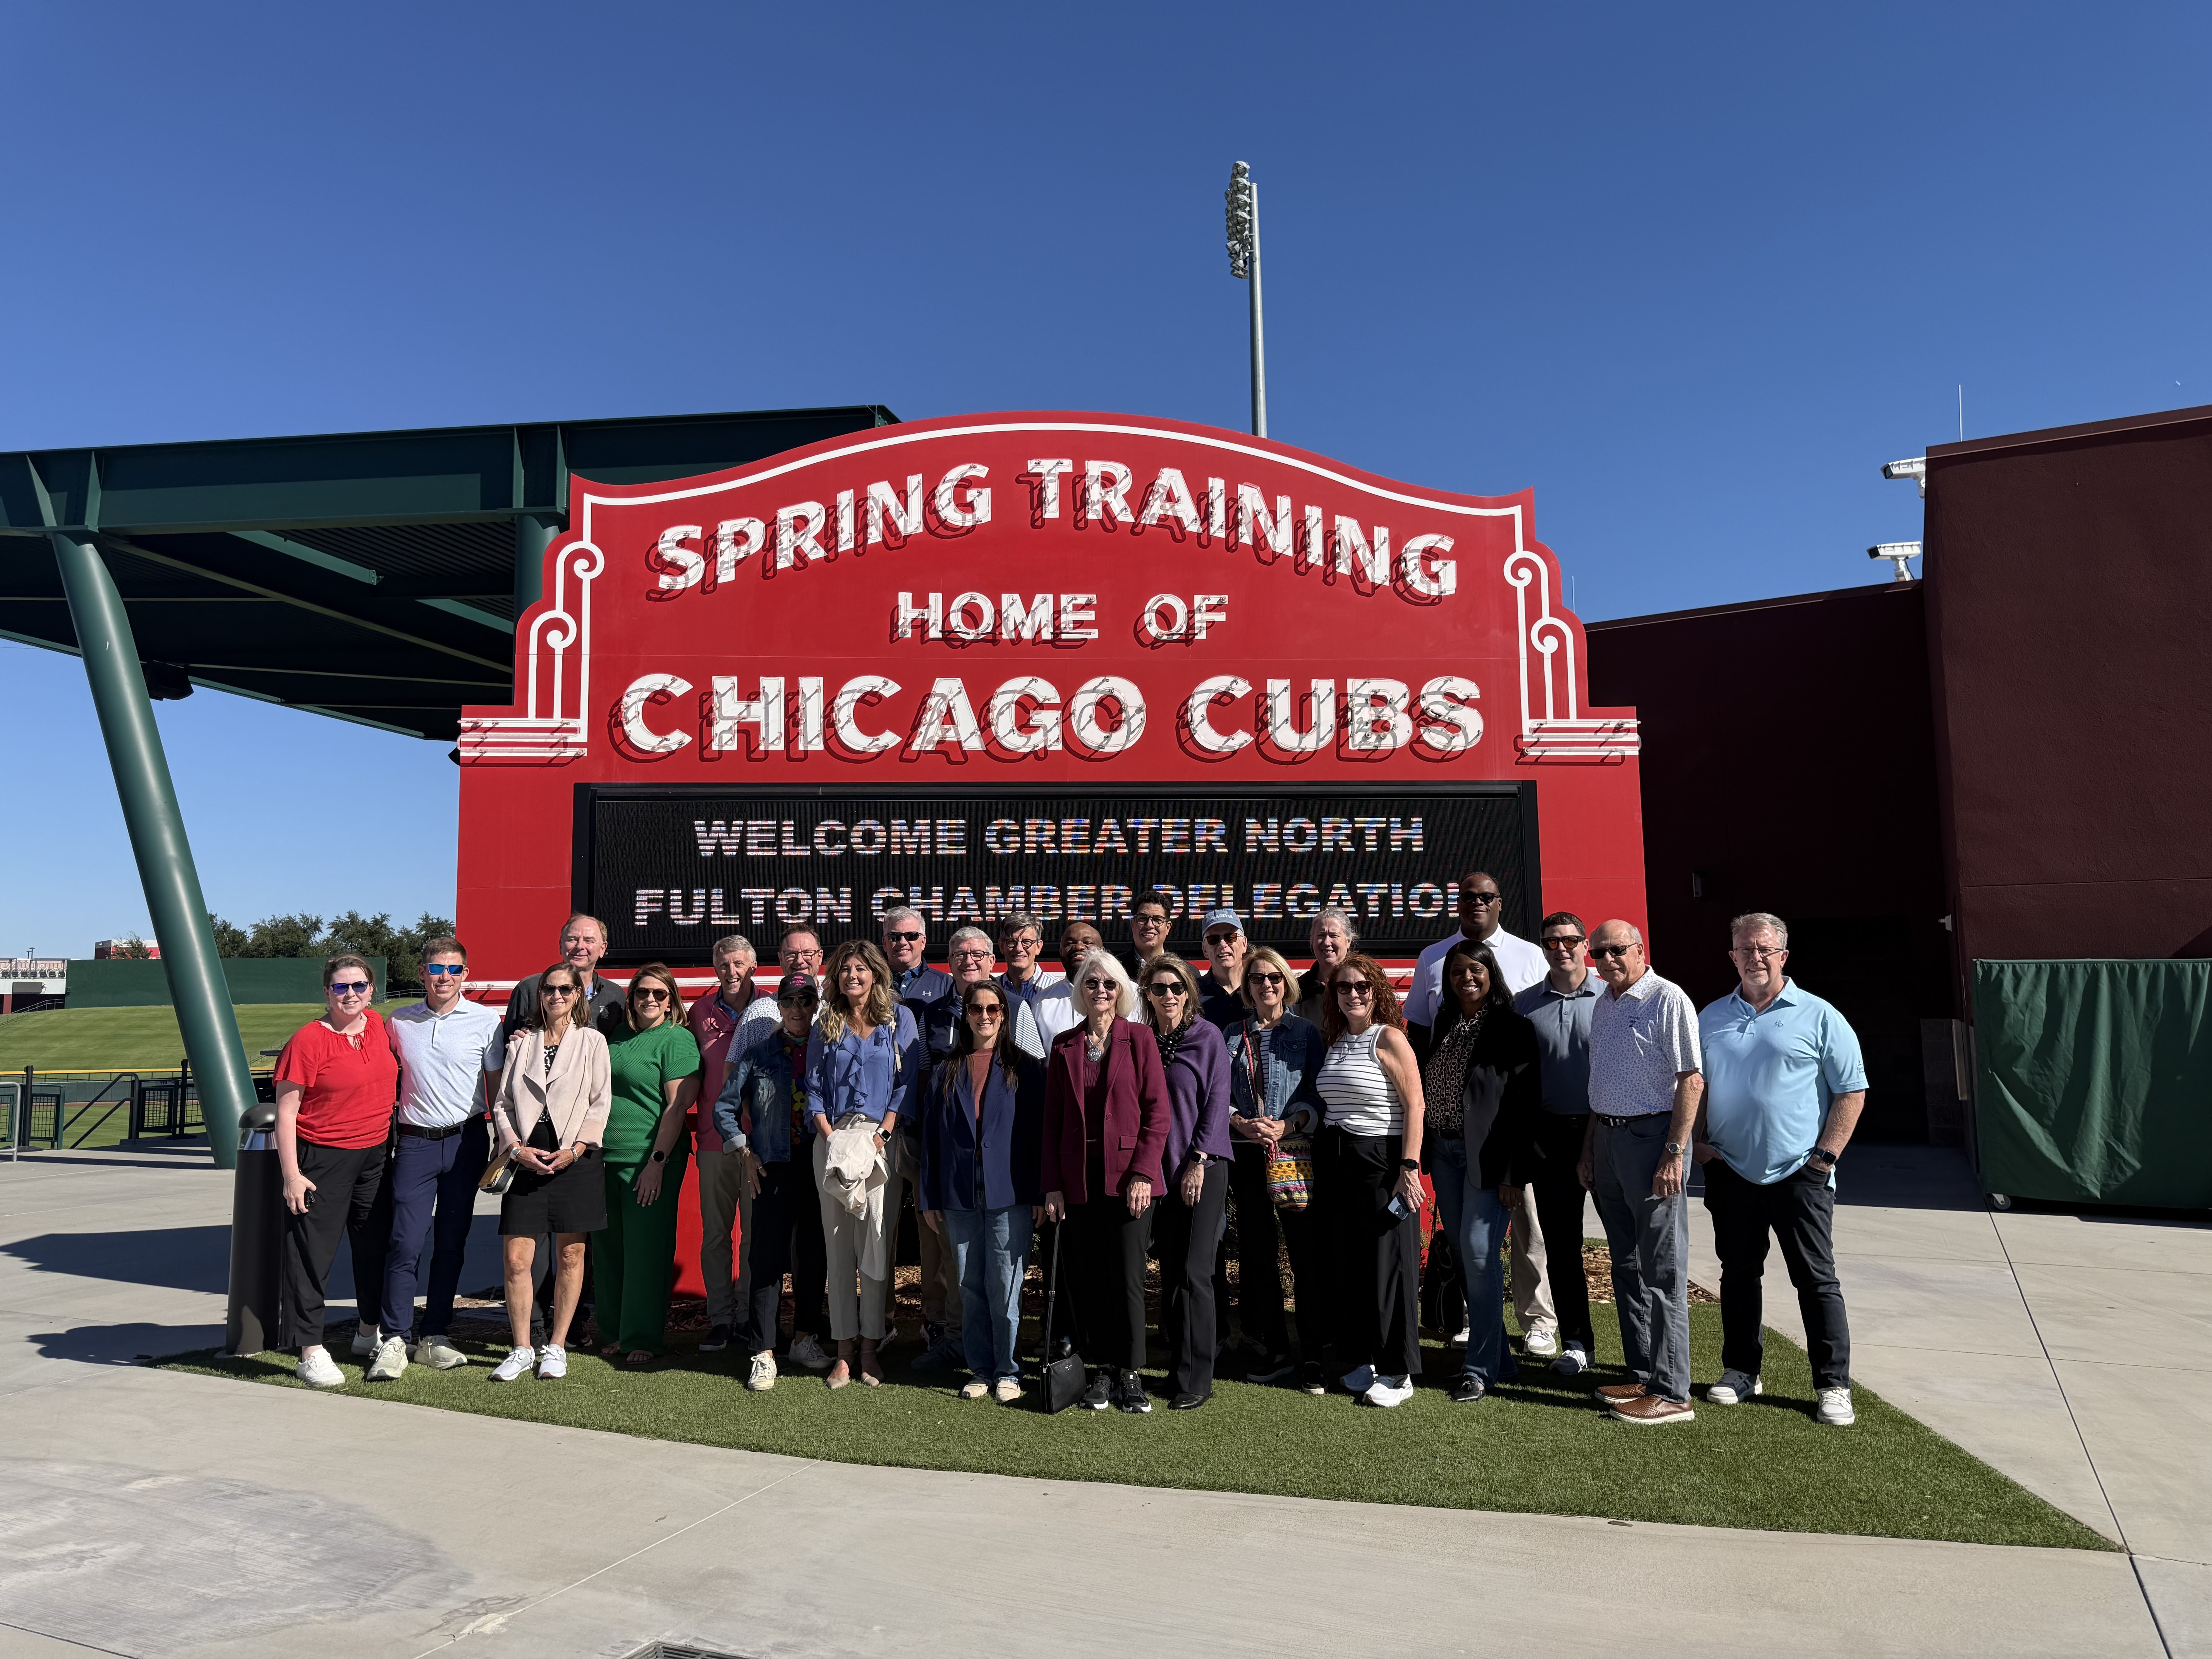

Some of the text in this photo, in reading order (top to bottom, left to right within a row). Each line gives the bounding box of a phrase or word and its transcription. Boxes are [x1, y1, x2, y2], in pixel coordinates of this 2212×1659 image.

[658, 459, 1457, 596] SPRING TRAINING
[898, 592, 1229, 640] HOME OF
[621, 673, 1484, 753] CHICAGO CUBS
[693, 817, 1424, 857] WELCOME GREATER NORTH
[634, 887, 852, 926] FULTON
[871, 884, 1134, 922] CHAMBER
